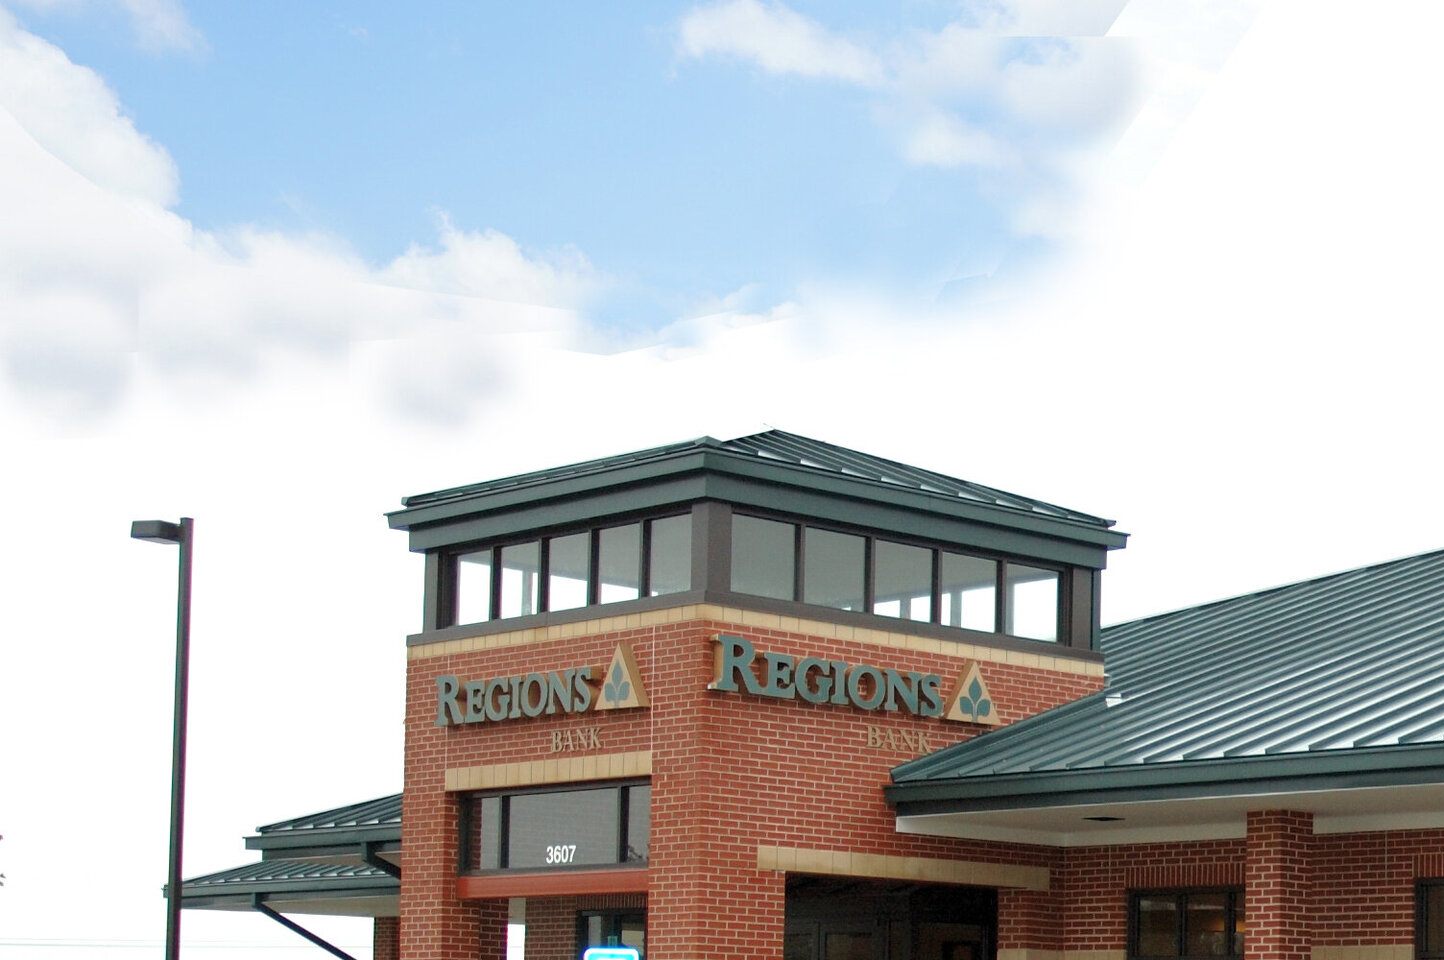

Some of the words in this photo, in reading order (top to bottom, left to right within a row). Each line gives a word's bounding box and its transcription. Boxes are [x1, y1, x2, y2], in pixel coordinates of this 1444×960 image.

[710, 633, 944, 718] REGIONS
[434, 666, 593, 728] REGIONS
[551, 727, 602, 753] BANK
[866, 724, 933, 753] BANK
[546, 844, 577, 864] 3607
